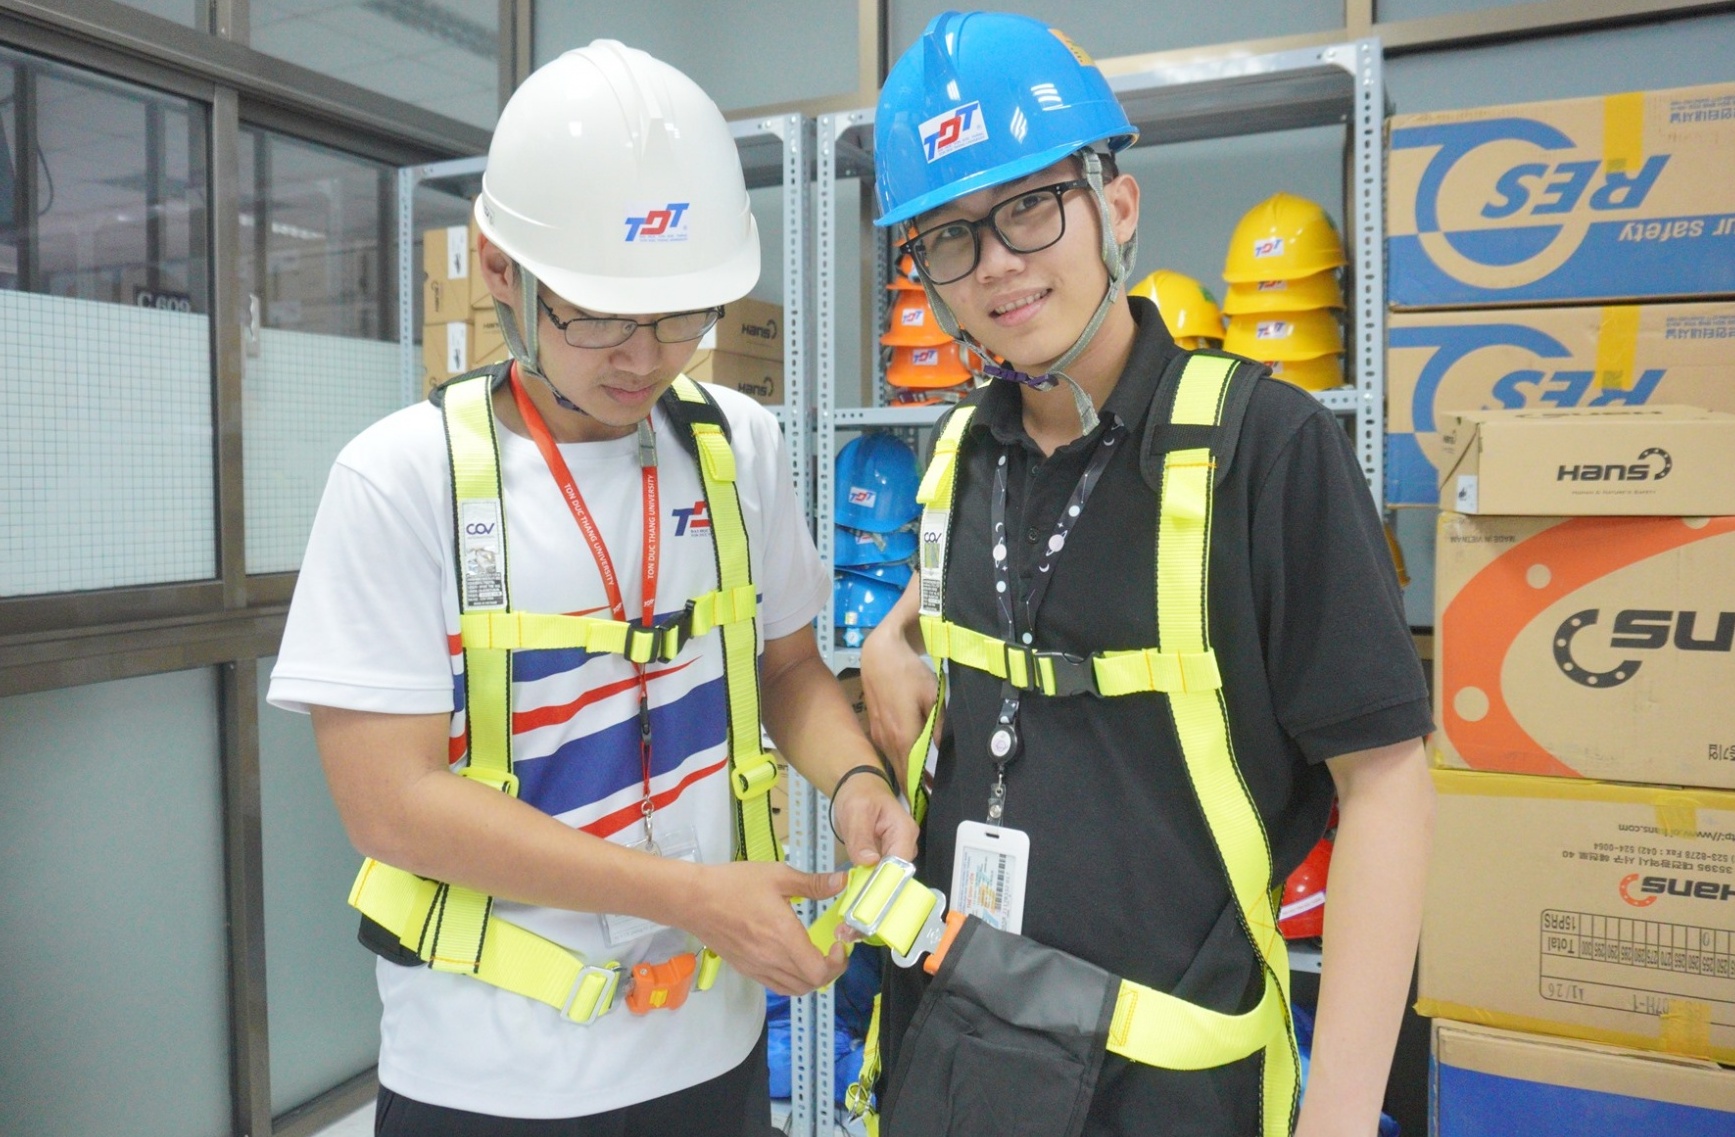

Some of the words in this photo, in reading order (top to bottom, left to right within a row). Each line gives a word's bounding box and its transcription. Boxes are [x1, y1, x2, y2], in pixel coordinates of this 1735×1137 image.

[923, 103, 980, 164] TDT
[1480, 154, 1672, 219] RES
[624, 202, 690, 242] TDT
[1618, 219, 1704, 242] safety
[647, 474, 656, 515] UNIVERSITY
[465, 522, 495, 535] COV
[564, 483, 577, 500] TON
[572, 499, 585, 516] DUC
[580, 516, 598, 543] THANG
[593, 542, 615, 586] UNIVERSITY
[648, 517, 656, 543] THANG
[647, 545, 656, 565] DUC
[647, 565, 655, 579] TON
[1547, 936, 1575, 954] Total
